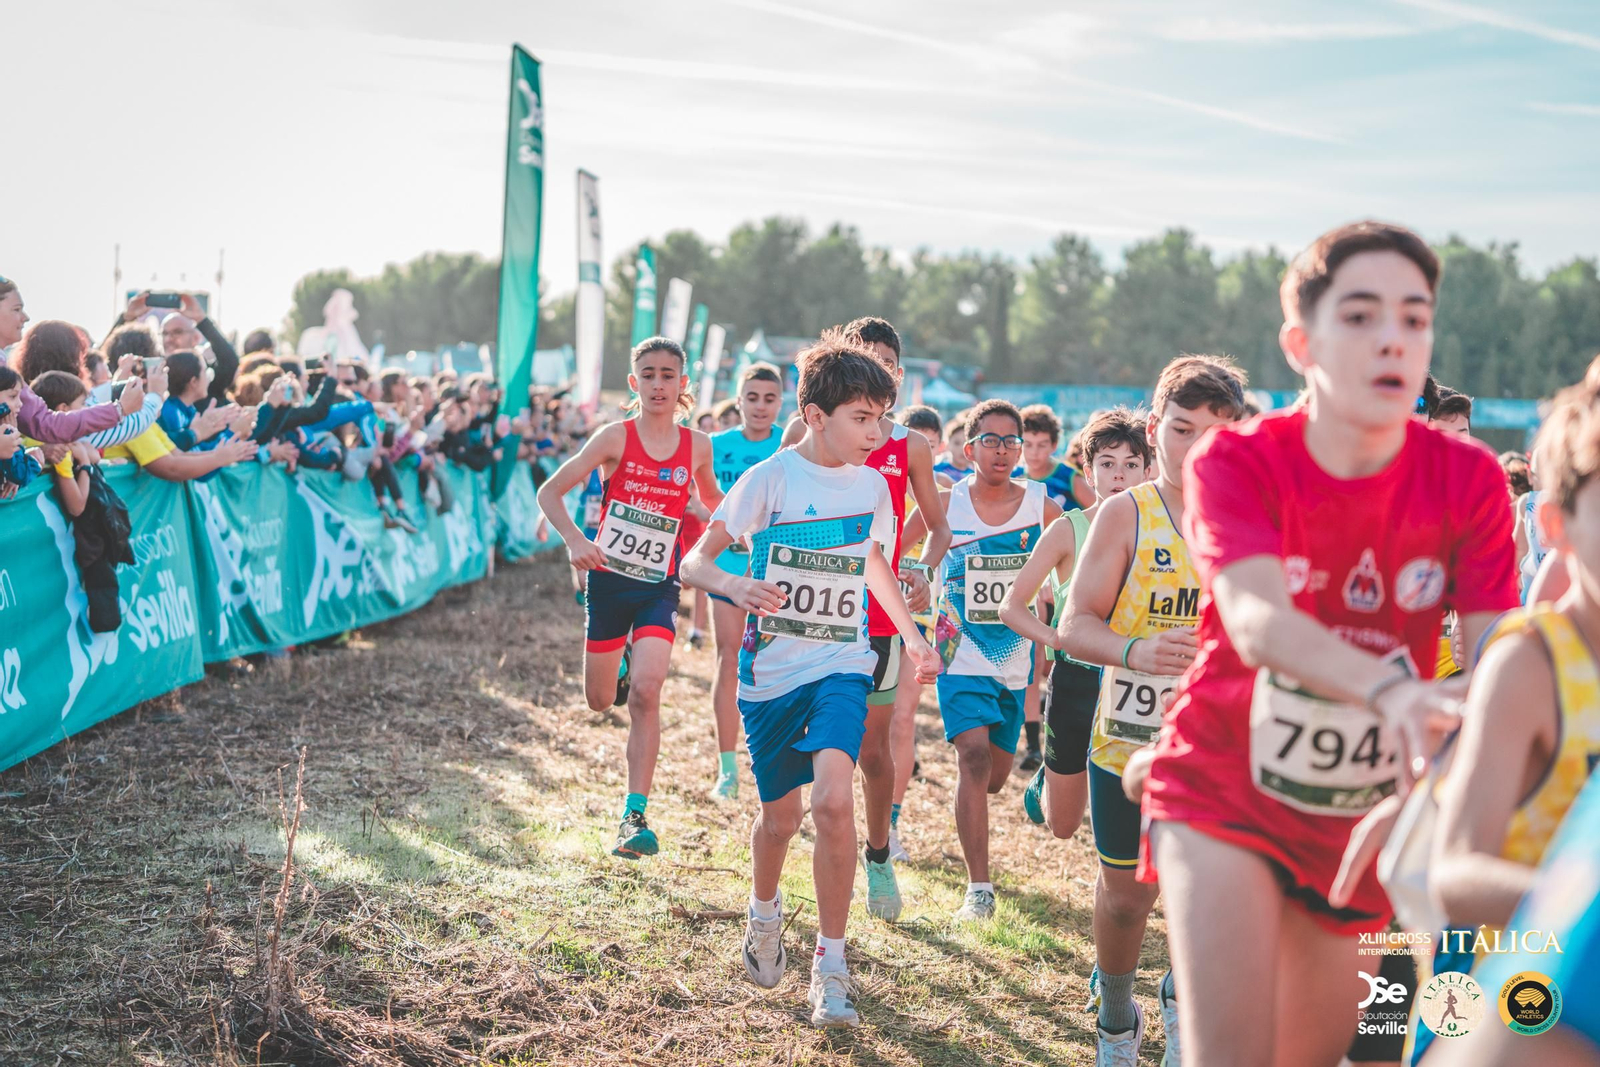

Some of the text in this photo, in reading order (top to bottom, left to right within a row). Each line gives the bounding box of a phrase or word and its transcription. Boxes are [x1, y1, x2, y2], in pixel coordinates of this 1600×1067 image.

[628, 510, 662, 526] ITÁLICA
[607, 527, 667, 564] 7943
[798, 552, 843, 568] ITÁLICA
[987, 556, 1023, 567] ITÁLICA
[973, 581, 1014, 604] 80
[1148, 587, 1200, 617] LaM
[127, 569, 196, 653] Sevilla
[1115, 678, 1172, 717] 79
[1273, 716, 1396, 772] 794
